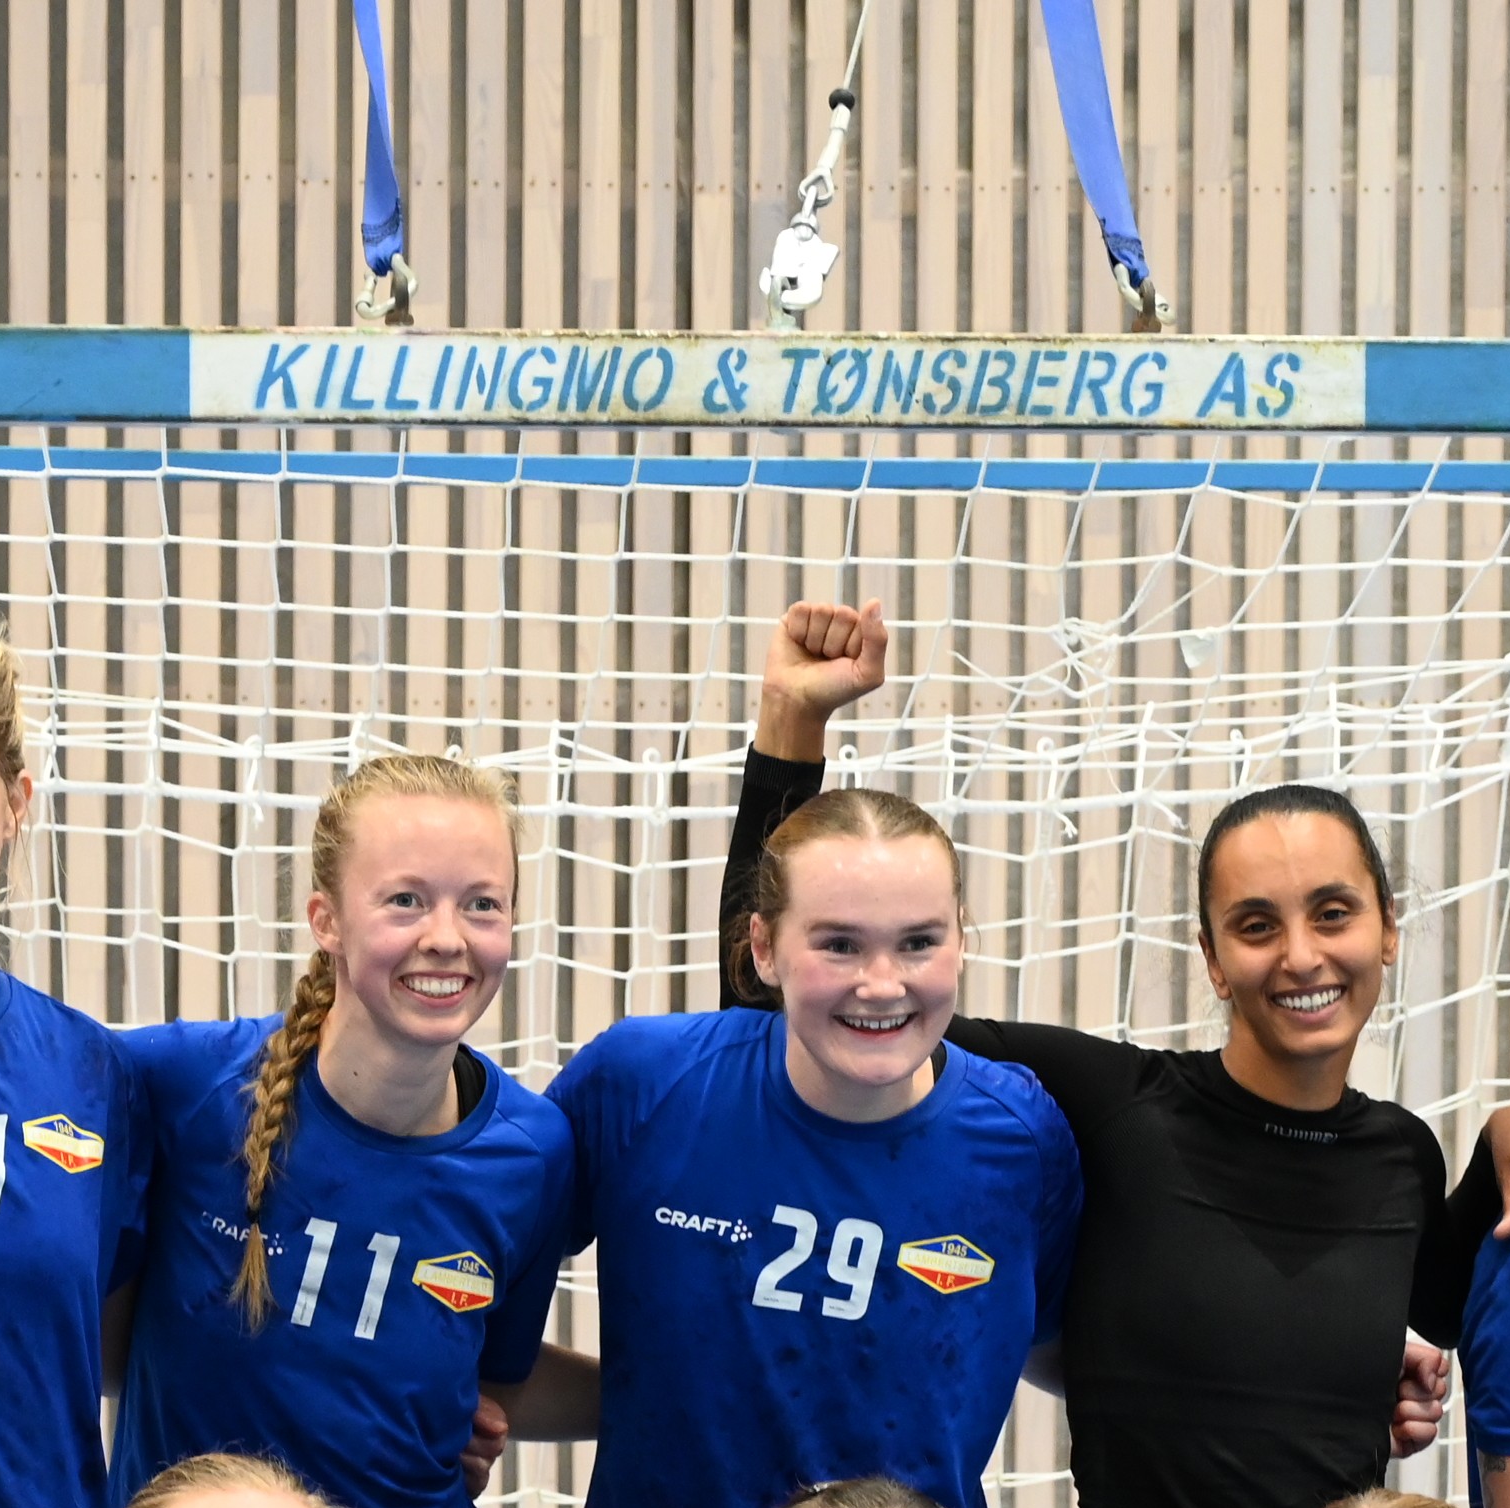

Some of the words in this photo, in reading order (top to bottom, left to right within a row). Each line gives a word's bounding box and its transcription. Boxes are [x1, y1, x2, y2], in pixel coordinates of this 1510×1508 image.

[255, 343, 674, 412] KILLINGMO
[702, 346, 750, 414] &
[780, 347, 1168, 417] TØNSBERG
[1197, 350, 1303, 419] AS
[53, 1120, 75, 1138] 1945
[655, 1207, 731, 1237] CRAFT
[751, 1204, 884, 1321] 29
[941, 1242, 968, 1258] 1945
[291, 1217, 401, 1342] 11
[457, 1259, 480, 1274] 1945
